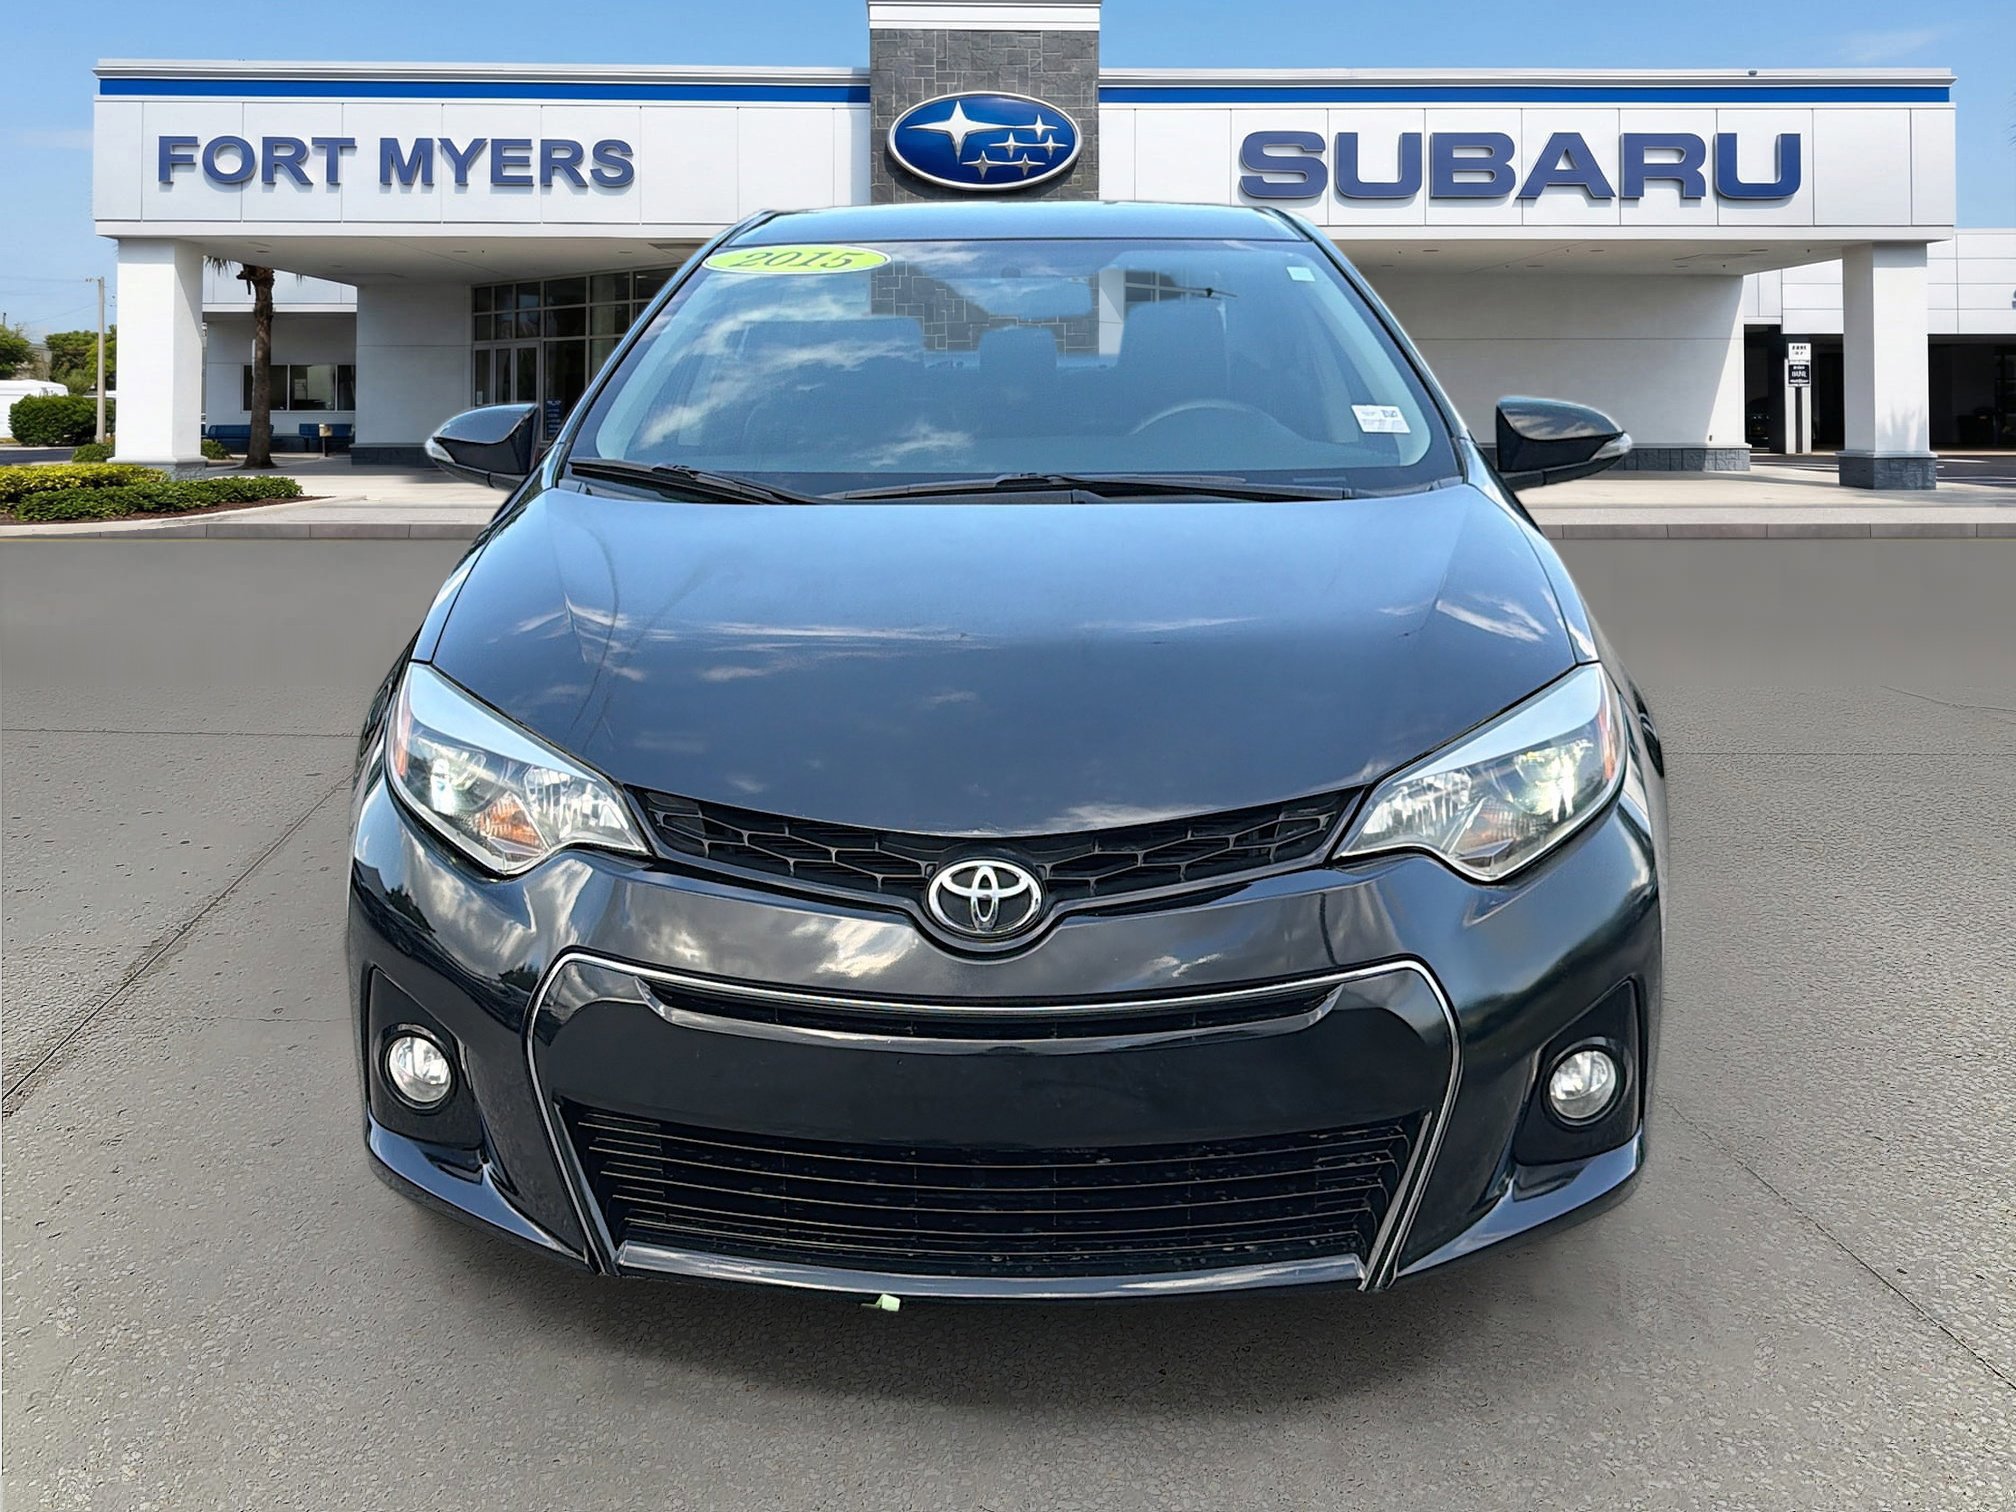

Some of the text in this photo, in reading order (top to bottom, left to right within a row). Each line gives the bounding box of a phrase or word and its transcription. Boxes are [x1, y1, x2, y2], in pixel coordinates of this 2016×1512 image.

[158, 135, 635, 188] FORT MYERS
[1239, 131, 1801, 200] SUBARU
[728, 251, 865, 269] 2015
